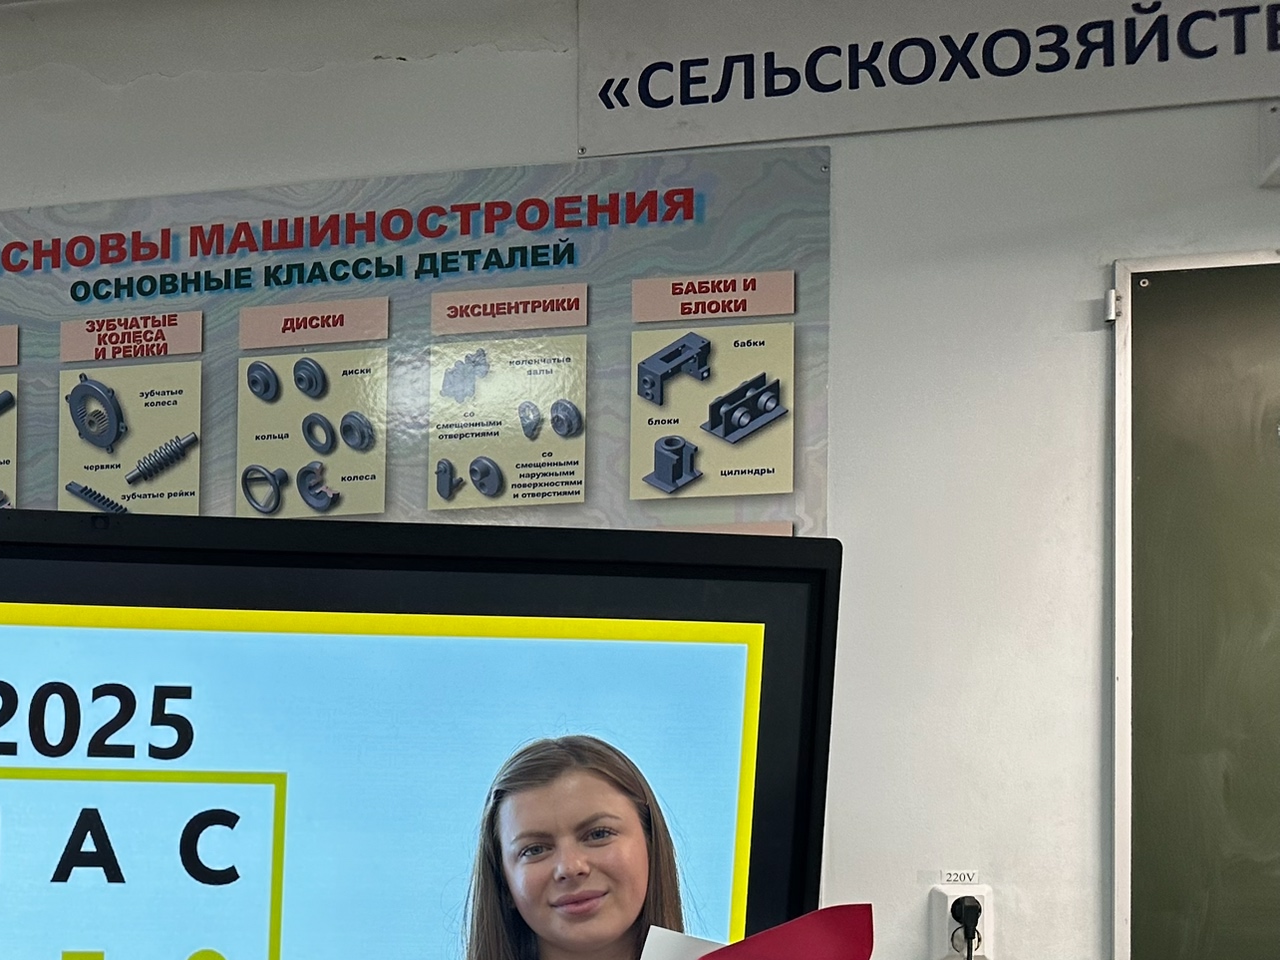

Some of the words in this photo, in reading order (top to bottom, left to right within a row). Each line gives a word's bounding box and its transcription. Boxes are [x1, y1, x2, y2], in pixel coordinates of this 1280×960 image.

[189, 187, 695, 257] МАШИНОСТРОЕНИЯ
[70, 266, 252, 302] ОСНОВНЫЕ
[264, 255, 403, 287] КЛАССЫ
[414, 238, 575, 279] ДЕТАЛЕЙ
[671, 279, 736, 295] БАБКИ
[743, 278, 757, 291] И
[446, 297, 580, 318] ЭКСЦЕНТРИКИ
[680, 299, 747, 315] БЛОКИ
[85, 314, 178, 333] ЗУБЧАТЫЕ
[281, 313, 345, 333] ДИСКИ
[97, 329, 166, 346] КОЛЕСА
[733, 339, 765, 348] бабки
[94, 347, 107, 360] И
[112, 340, 168, 359] РЕЙКИ
[508, 356, 571, 367] коленчатые
[341, 367, 372, 377] диски
[139, 387, 184, 399] зубчатые
[144, 399, 178, 408] колеса
[436, 419, 502, 431] смещенными
[647, 417, 680, 426] блоки
[254, 432, 289, 442] кольца
[438, 430, 500, 441] отверстиями
[83, 462, 121, 473] червяки
[515, 459, 579, 471] смещенными
[340, 473, 376, 482] колеса
[519, 469, 575, 481] наружными
[720, 466, 775, 477] цилиндры
[511, 479, 583, 491] поверхностями
[121, 491, 165, 501] зубчатые
[167, 489, 196, 500] рейки
[522, 489, 581, 500] отверстиями
[946, 872, 975, 882] 220V
